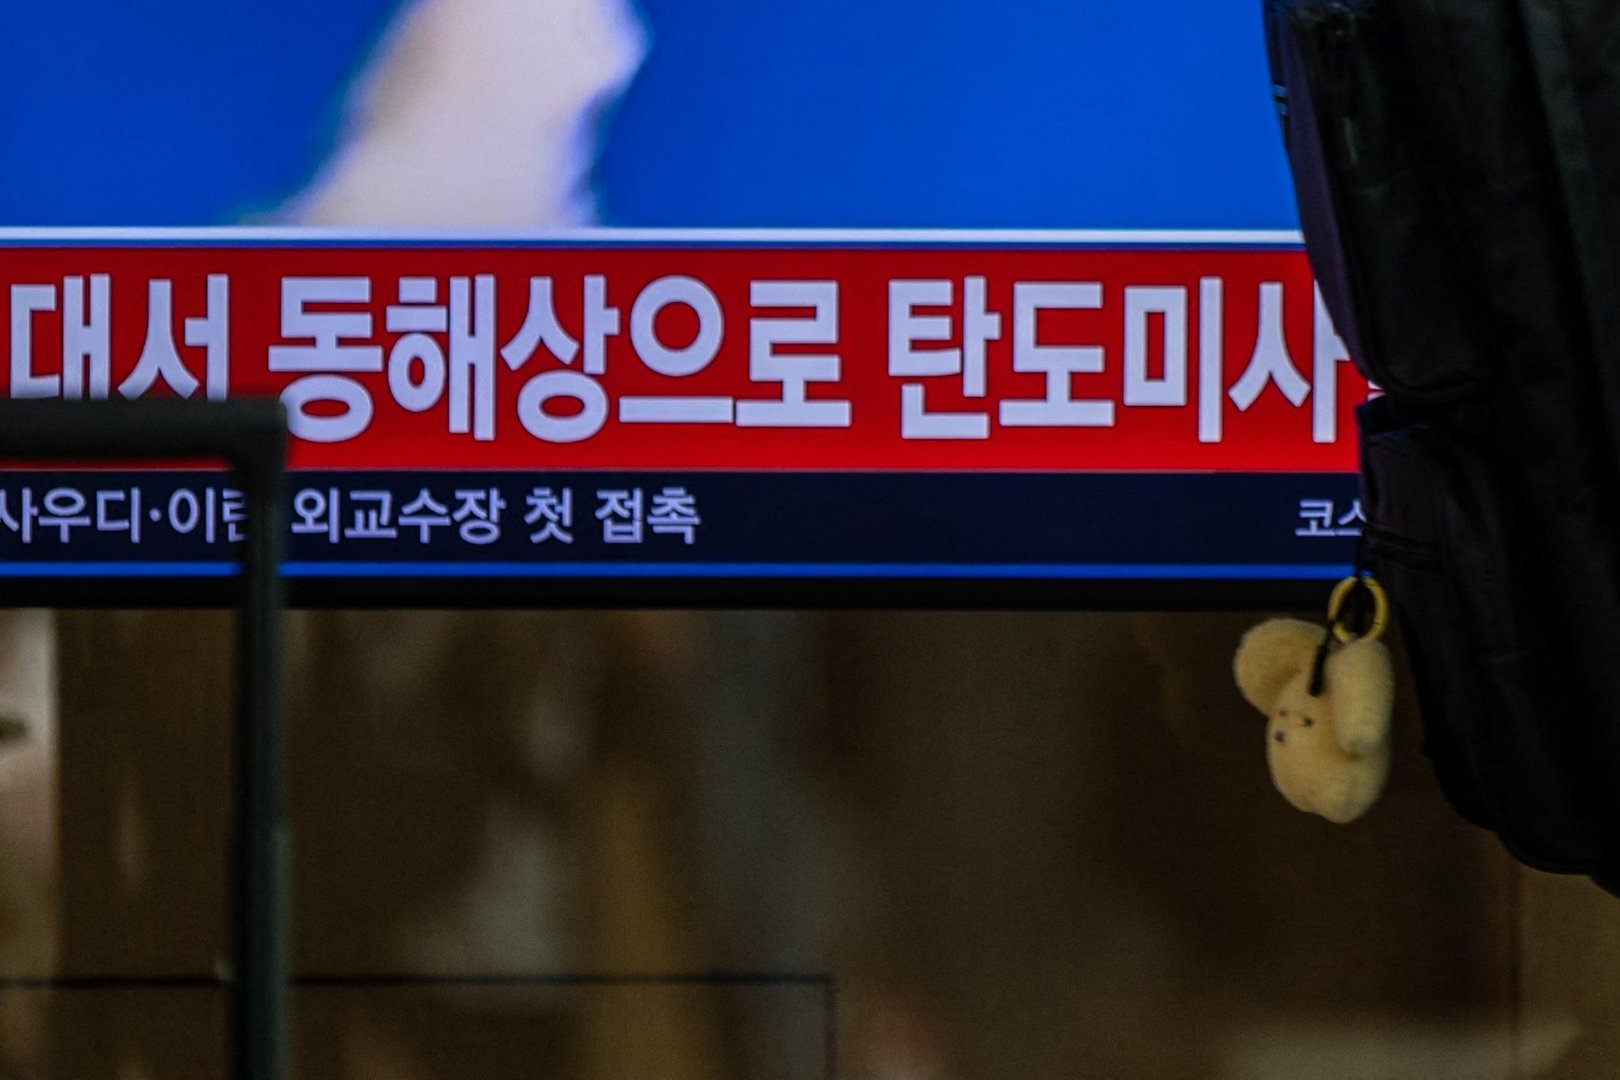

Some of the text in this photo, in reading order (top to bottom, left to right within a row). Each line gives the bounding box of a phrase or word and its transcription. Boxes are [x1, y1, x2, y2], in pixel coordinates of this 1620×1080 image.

[10, 274, 1386, 443] 대서 동해상으로 탄도미사
[291, 488, 506, 544] 외교수장
[524, 488, 573, 544] 첫
[595, 487, 701, 544] 접촉
